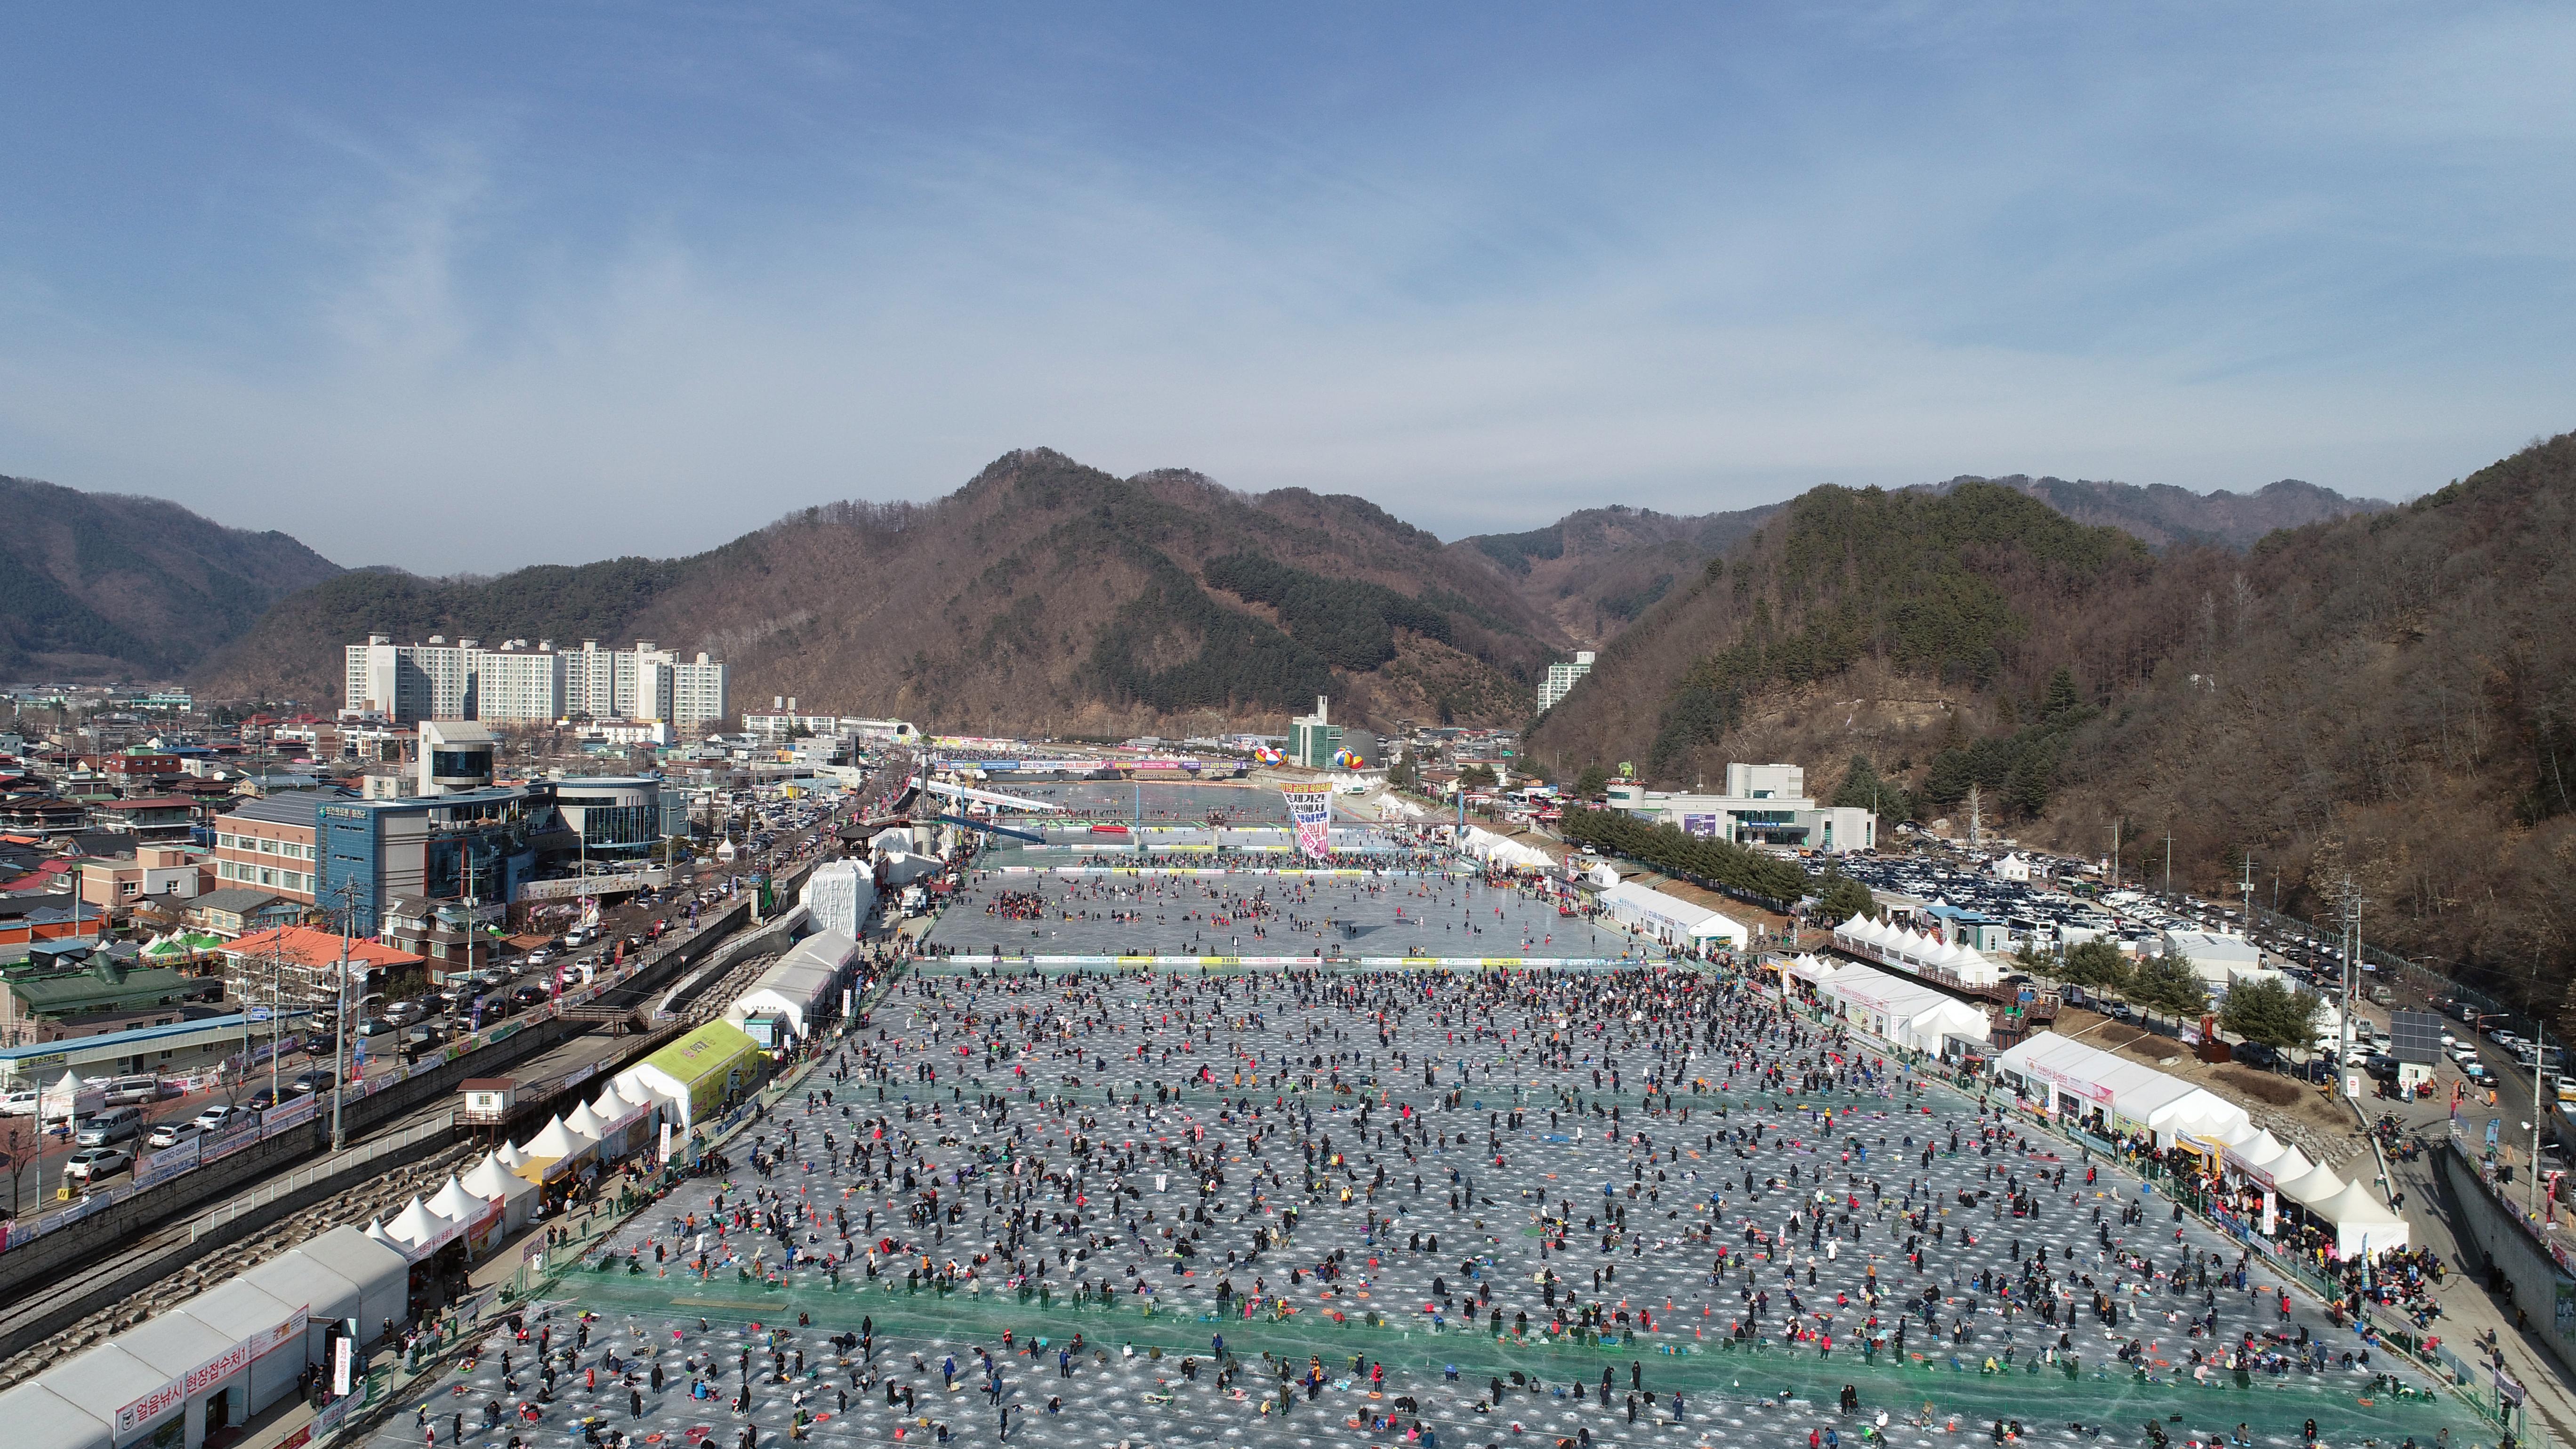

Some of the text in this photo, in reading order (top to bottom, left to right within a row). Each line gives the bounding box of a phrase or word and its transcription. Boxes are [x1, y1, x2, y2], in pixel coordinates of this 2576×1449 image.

[1293, 783, 1309, 792] 글로벌
[1310, 782, 1332, 792] 육성축제
[325, 806, 349, 817] 보건의료원
[2037, 1064, 2052, 1079] 산천어
[137, 1346, 246, 1422] 얼음낚시 현장접수처1
